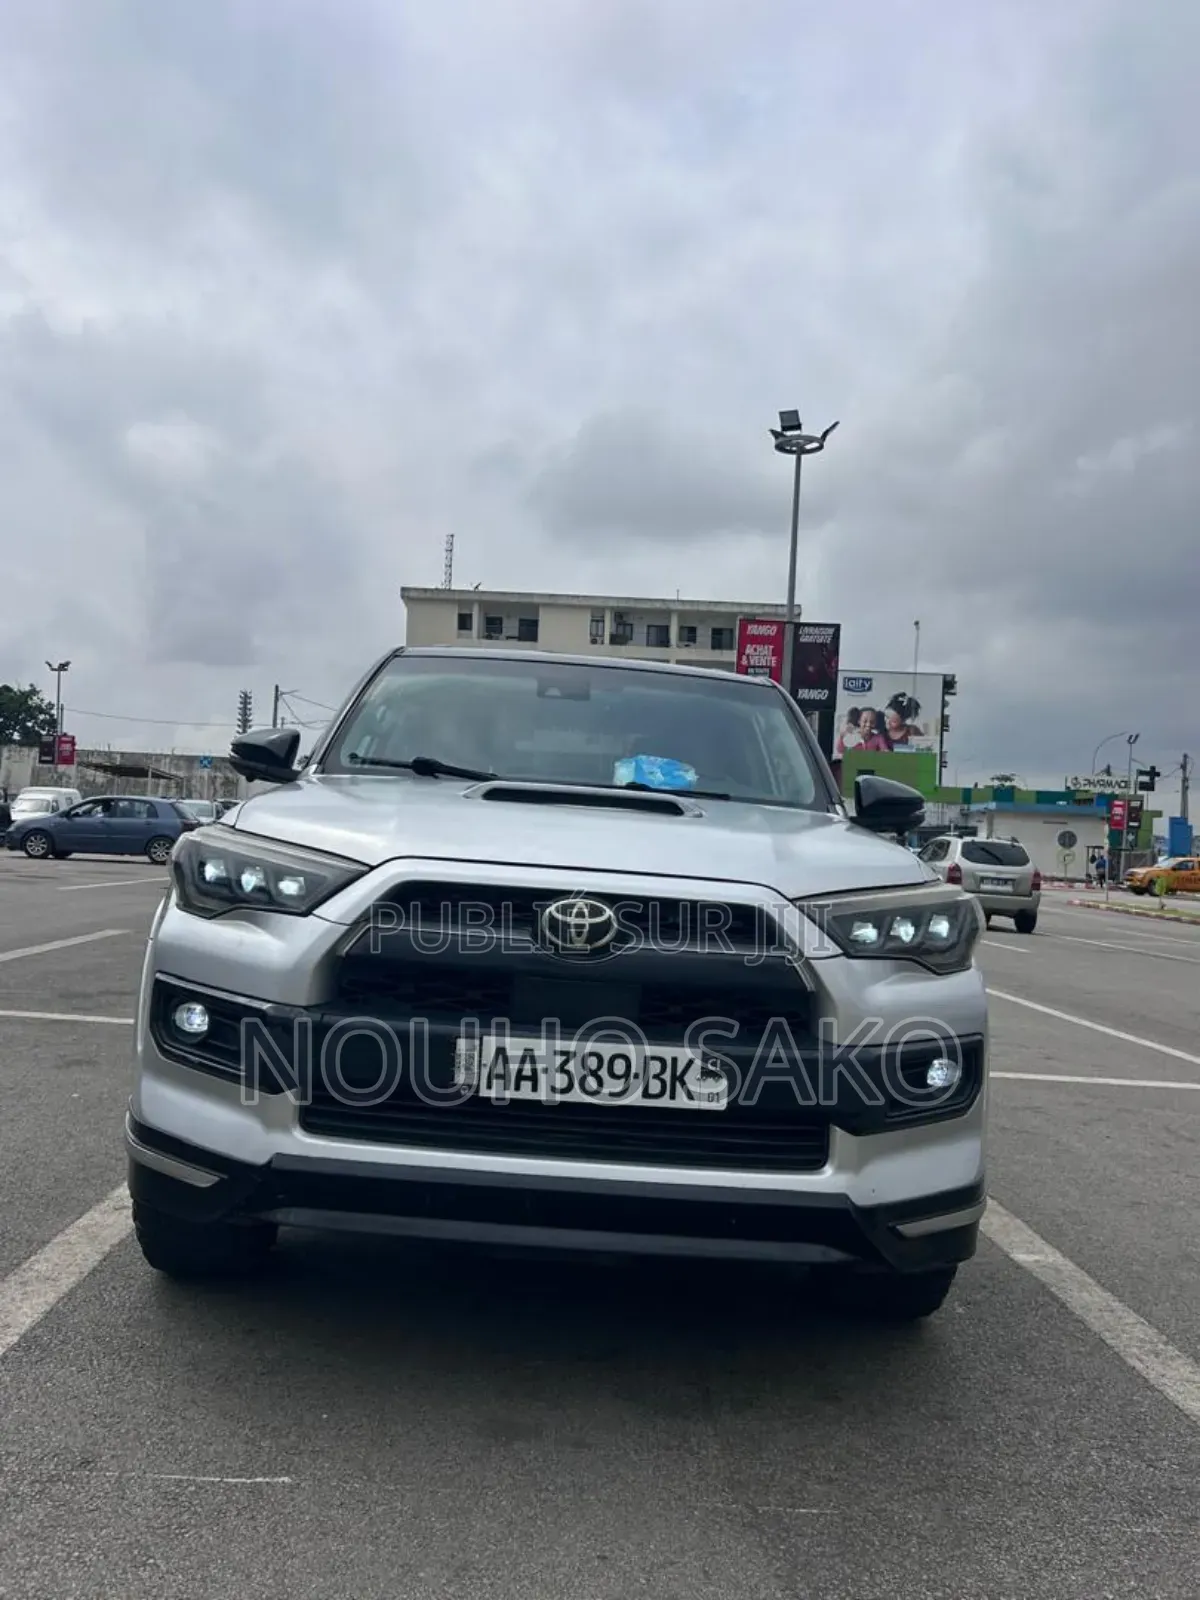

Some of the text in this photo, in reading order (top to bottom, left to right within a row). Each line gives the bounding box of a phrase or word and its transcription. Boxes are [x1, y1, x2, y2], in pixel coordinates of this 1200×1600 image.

[746, 624, 777, 636] YANGO
[745, 644, 775, 656] ACHAT
[740, 655, 777, 667] & VENTE
[797, 688, 829, 700] YANGO
